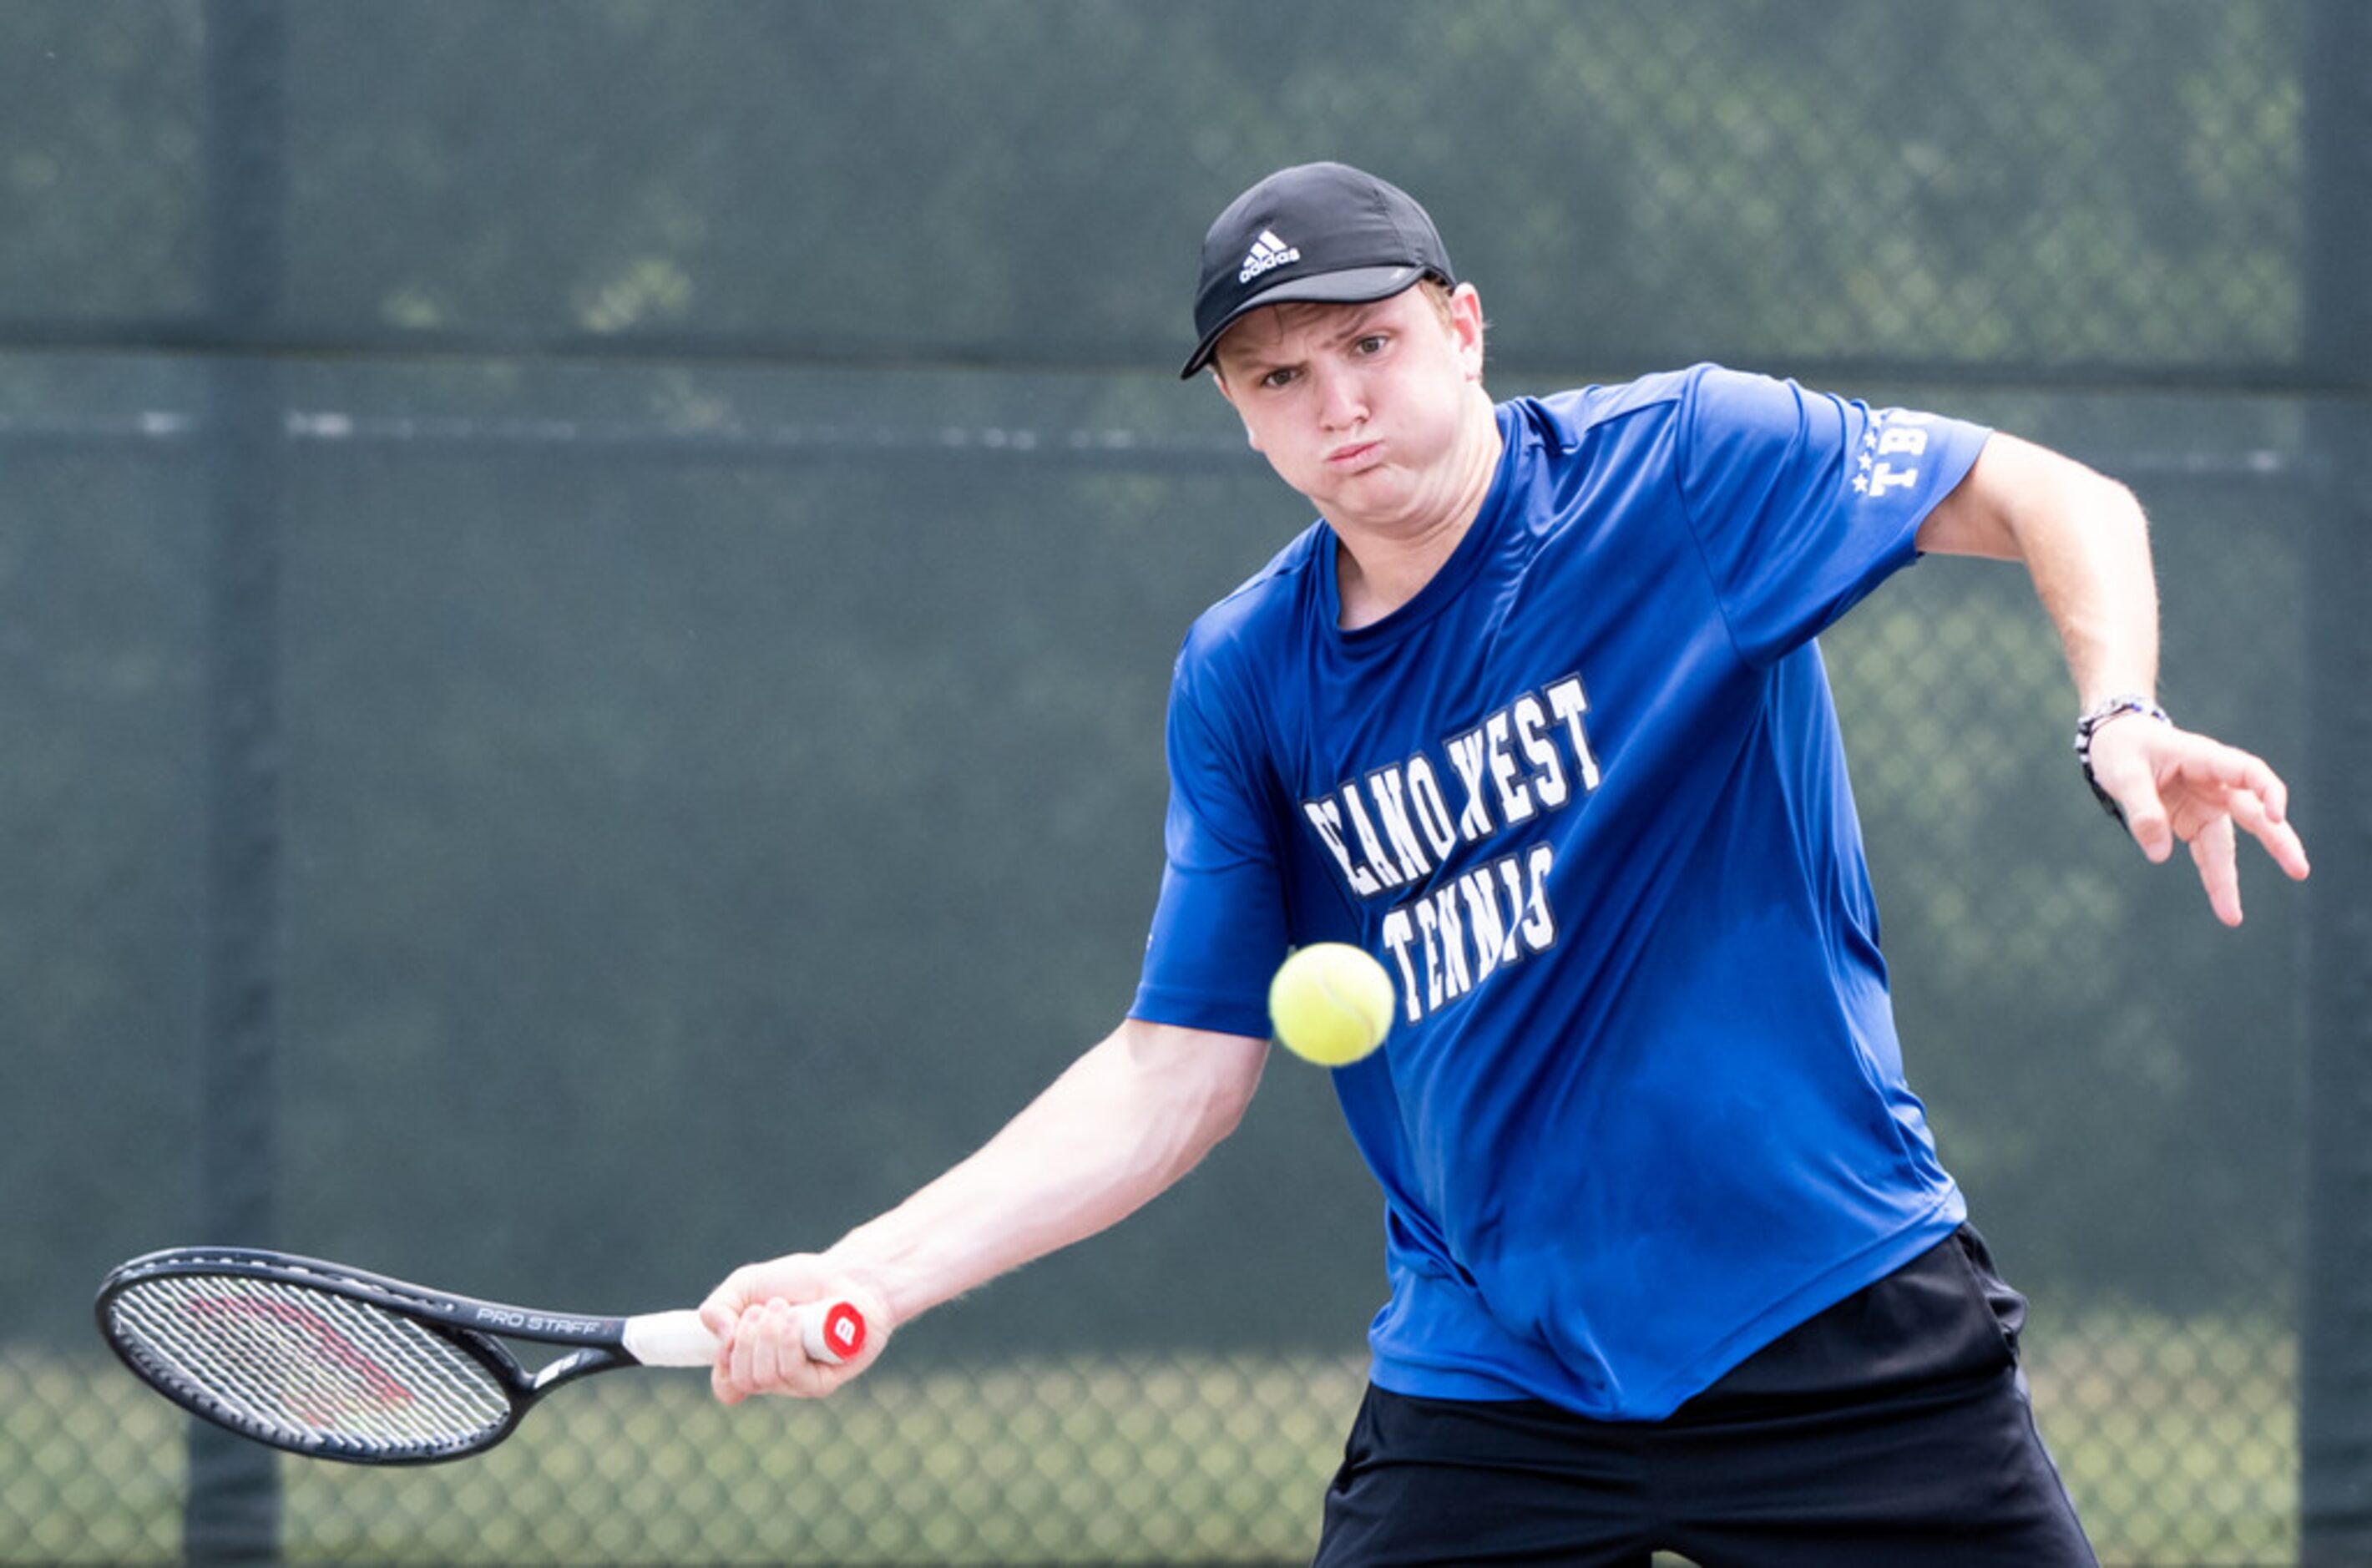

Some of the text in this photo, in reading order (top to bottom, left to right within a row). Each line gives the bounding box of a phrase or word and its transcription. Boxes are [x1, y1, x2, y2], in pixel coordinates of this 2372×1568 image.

[1239, 248, 1300, 283] adidas
[1447, 675, 1600, 842] WEST
[1381, 843, 1556, 1024] TENNIS
[477, 1308, 524, 1328] PRO
[527, 1316, 600, 1335] STAFF
